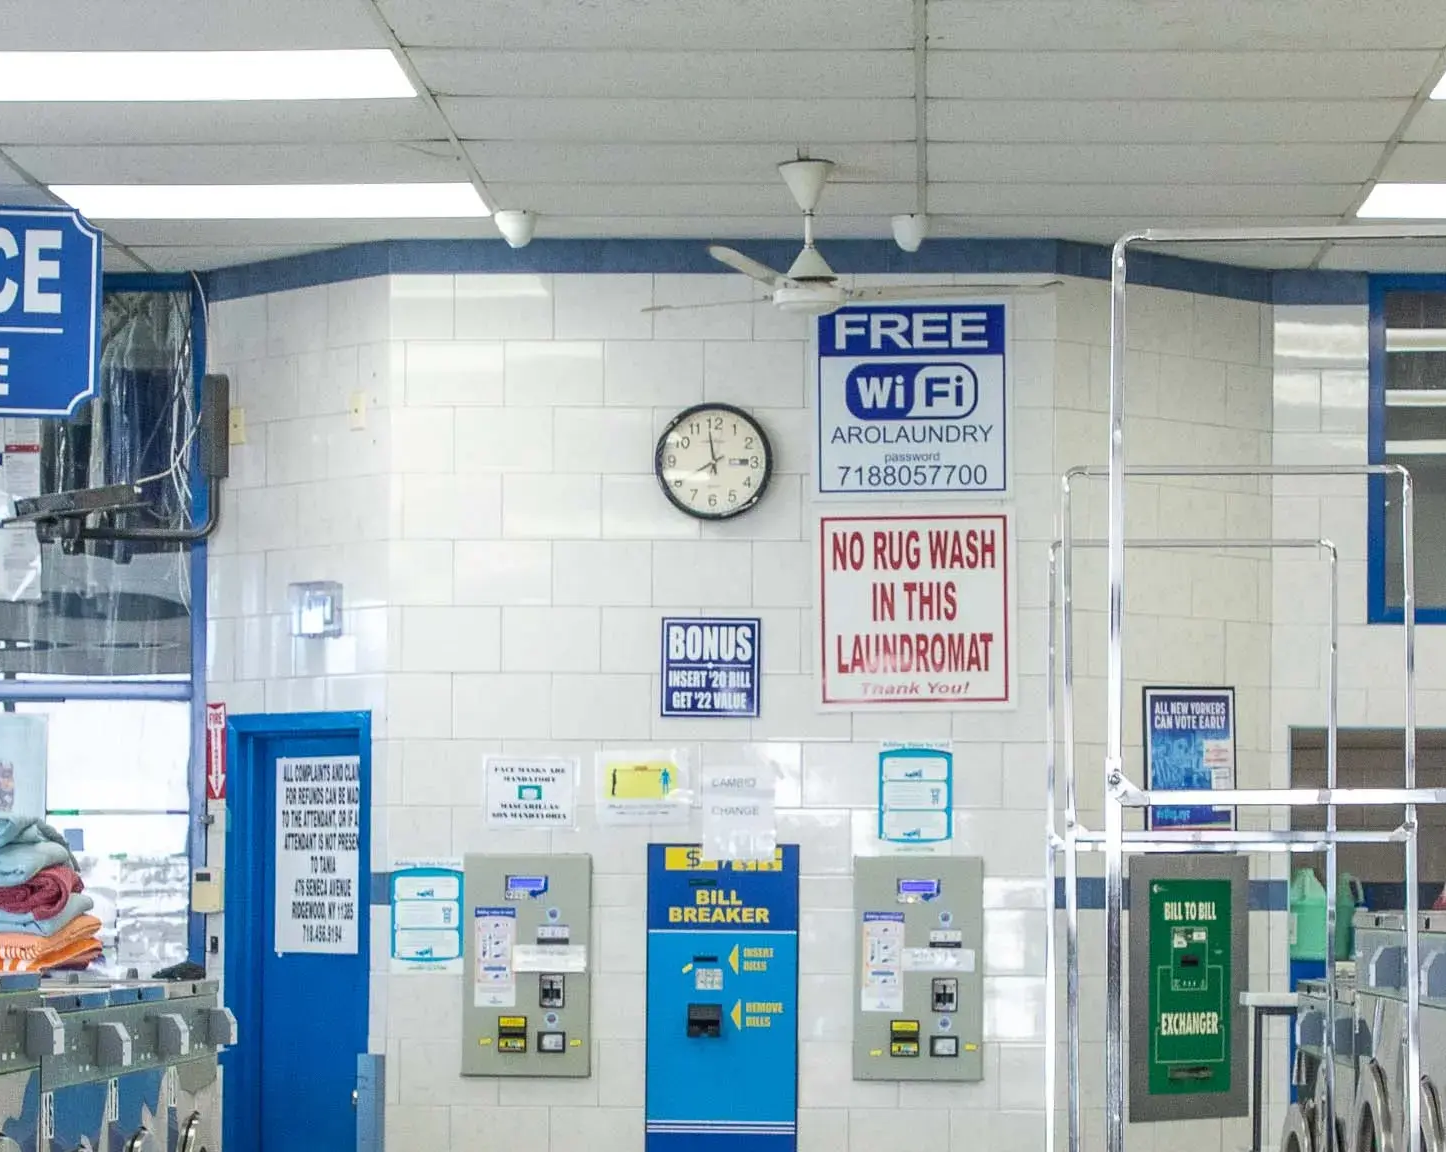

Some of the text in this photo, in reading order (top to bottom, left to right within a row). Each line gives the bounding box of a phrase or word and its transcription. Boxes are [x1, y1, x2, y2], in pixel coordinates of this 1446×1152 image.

[835, 312, 988, 349] FREE
[690, 423, 700, 434] 11
[707, 417, 723, 430] 12
[732, 423, 738, 436] 1
[831, 425, 993, 444] AROLAUNDRY
[744, 437, 754, 449] 2
[667, 454, 676, 468] 9
[750, 456, 759, 469] 3
[884, 452, 940, 464] password
[742, 476, 751, 488] 4
[838, 464, 987, 486] 7188057700
[690, 489, 698, 500] 7
[708, 493, 717, 506] 6
[728, 489, 737, 503] 5
[833, 529, 996, 570] NO RUG WASH
[872, 581, 957, 621] IN THIS
[669, 625, 752, 662] BONUS
[837, 633, 994, 674] LAUNDROMAT
[668, 670, 707, 688] INSERT
[728, 670, 751, 688] BILL
[861, 681, 970, 695] Thank You!
[672, 691, 693, 709] GET
[713, 691, 747, 709] VALUE
[1155, 701, 1226, 715] ALL NEW YORKERS
[1154, 715, 1226, 730] CAN VOTE EARLY
[284, 764, 294, 782] ALL
[295, 764, 331, 782] COMPLAINTS
[332, 764, 343, 782] AND
[494, 766, 514, 774] FACE
[518, 766, 546, 774] MASKS
[285, 787, 297, 805] FOR
[298, 787, 324, 805] REFUNDS
[325, 787, 337, 805] CAN
[338, 787, 346, 805] BE
[282, 810, 290, 828] TO
[291, 810, 302, 828] THE
[339, 810, 346, 828] OR
[347, 810, 353, 828] IF
[284, 833, 317, 851] ATTENDANT
[318, 833, 324, 851] IS
[325, 833, 337, 851] NOT
[310, 856, 318, 874] TO
[329, 879, 351, 896] AVENUE
[696, 889, 743, 905] BILL
[668, 908, 770, 923] BREAKER
[1164, 902, 1217, 921] BILL TO BILL
[1161, 1012, 1218, 1036] EXCHANGER
